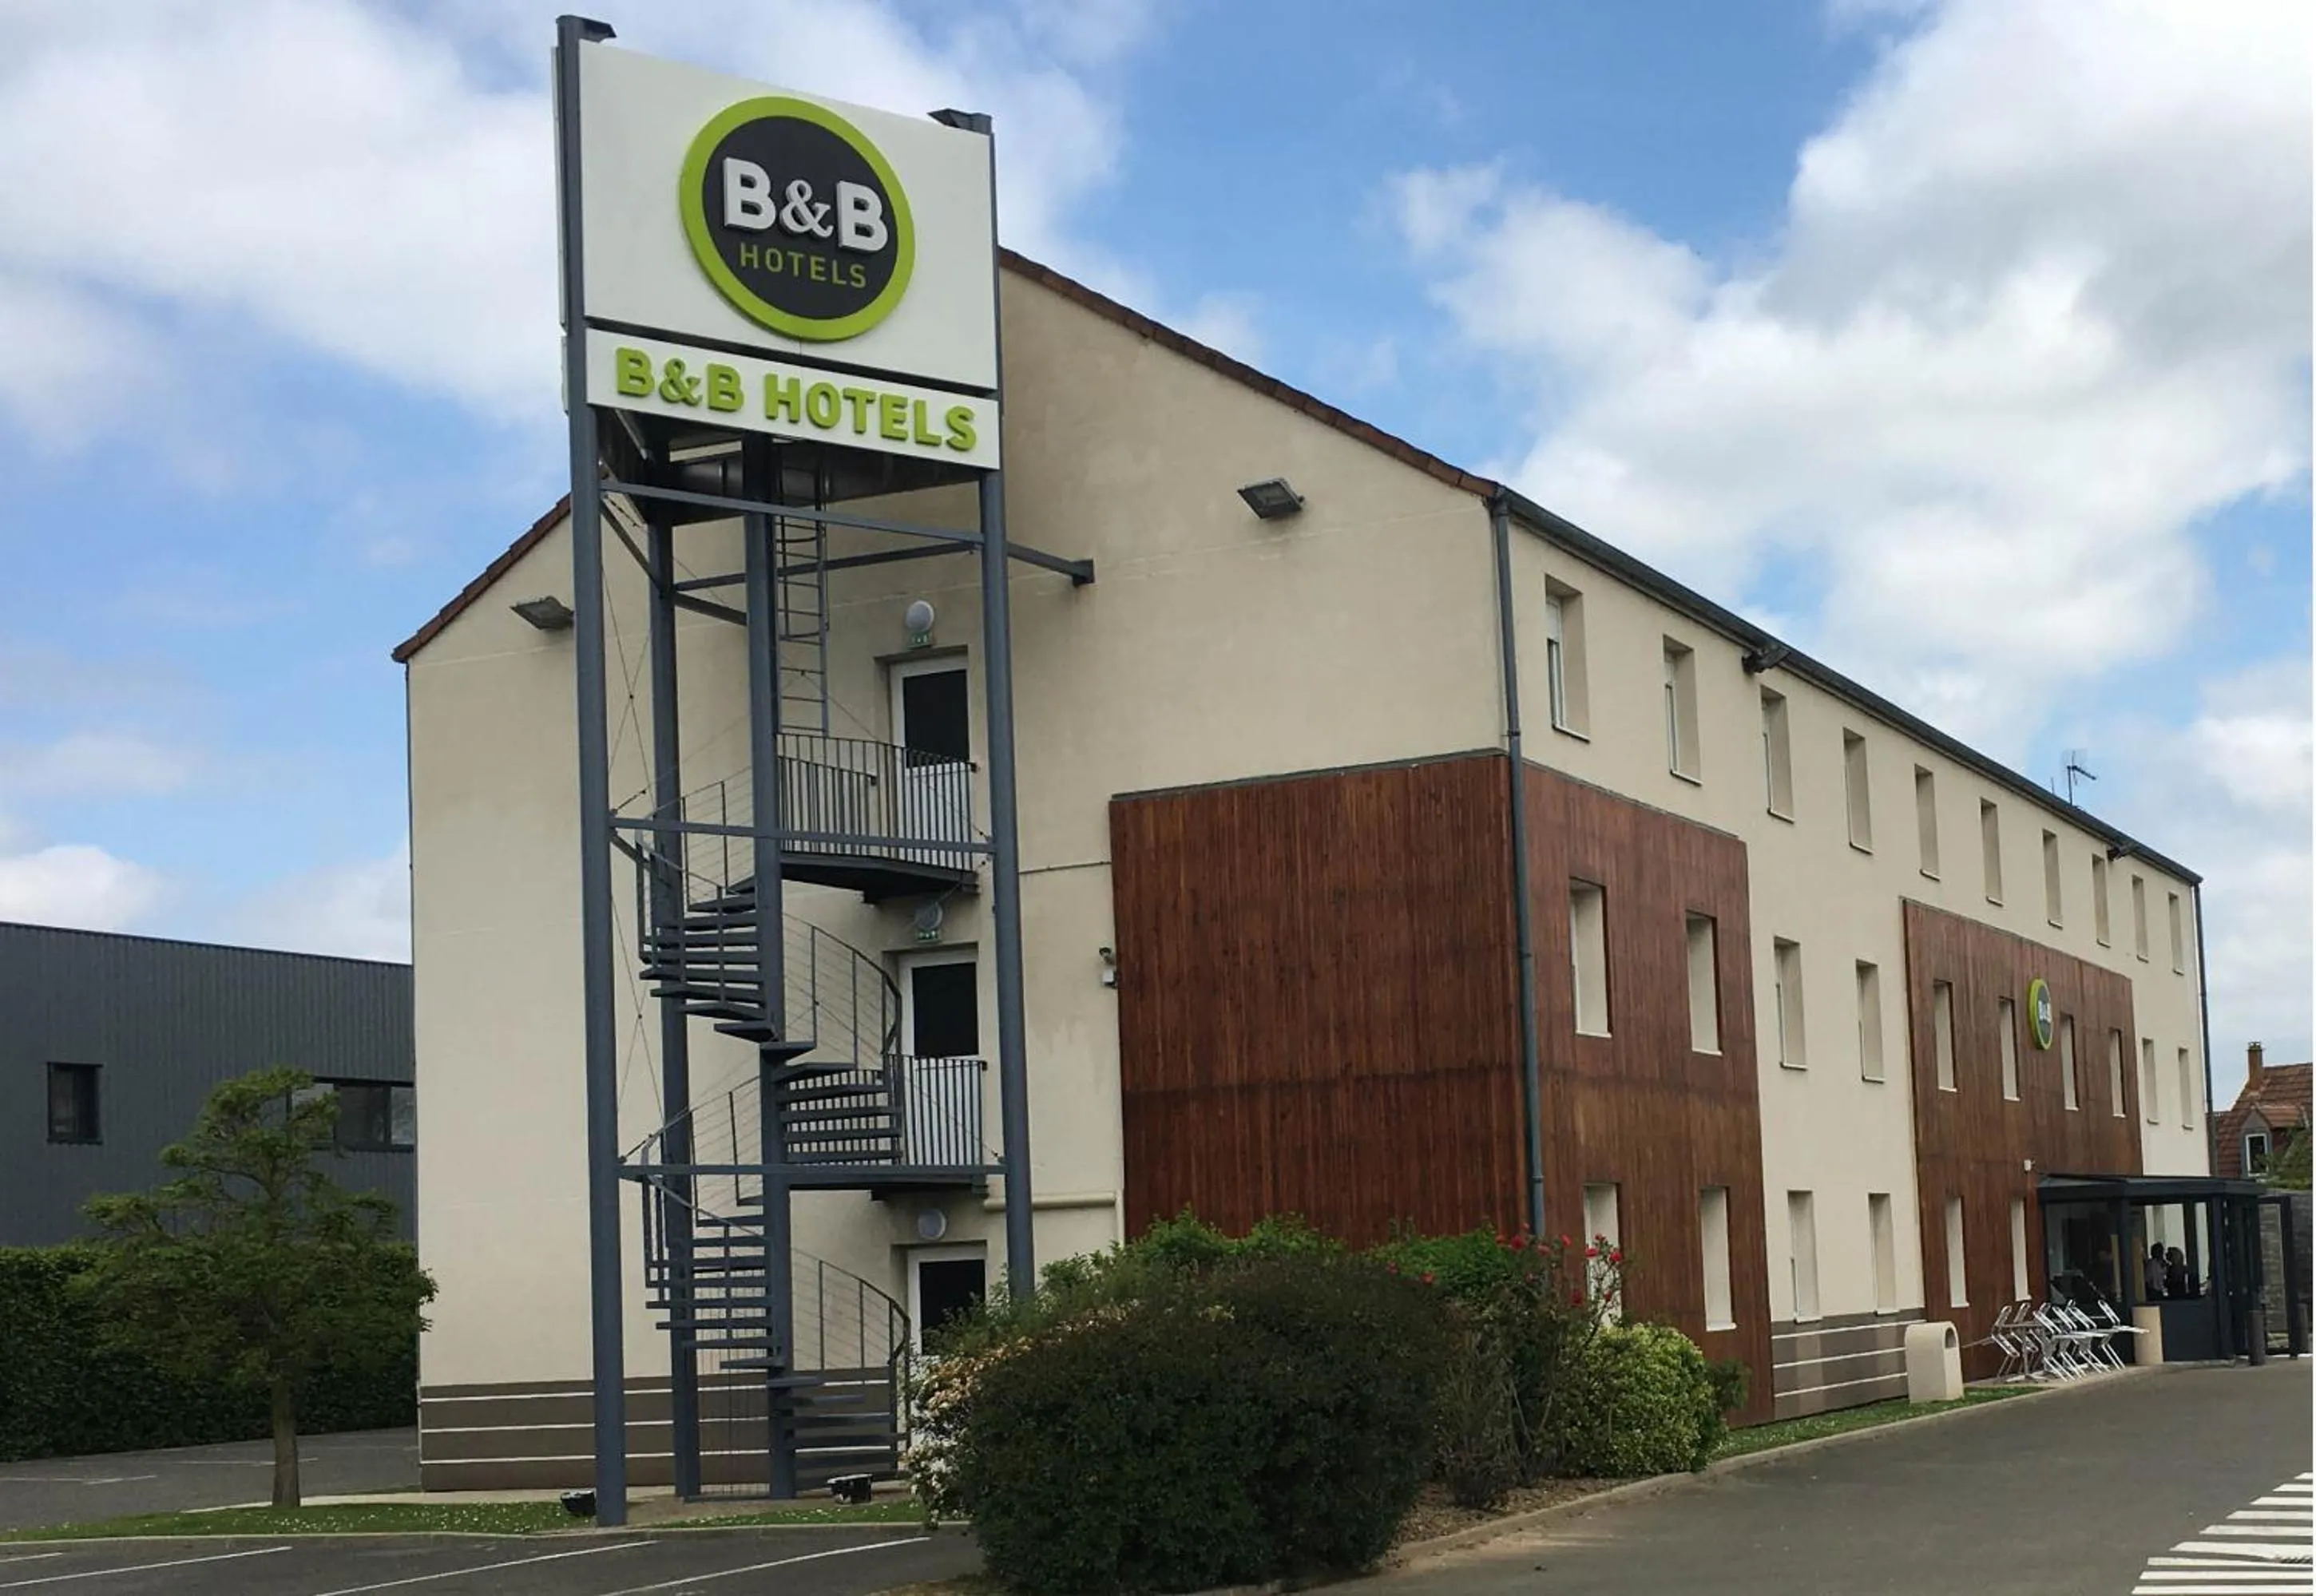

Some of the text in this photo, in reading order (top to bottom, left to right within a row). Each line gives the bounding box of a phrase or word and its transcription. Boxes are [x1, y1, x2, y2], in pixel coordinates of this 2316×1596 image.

[724, 158, 888, 251] B&B
[740, 243, 867, 288] HOTELS
[616, 347, 977, 451] B&B HOTELS
